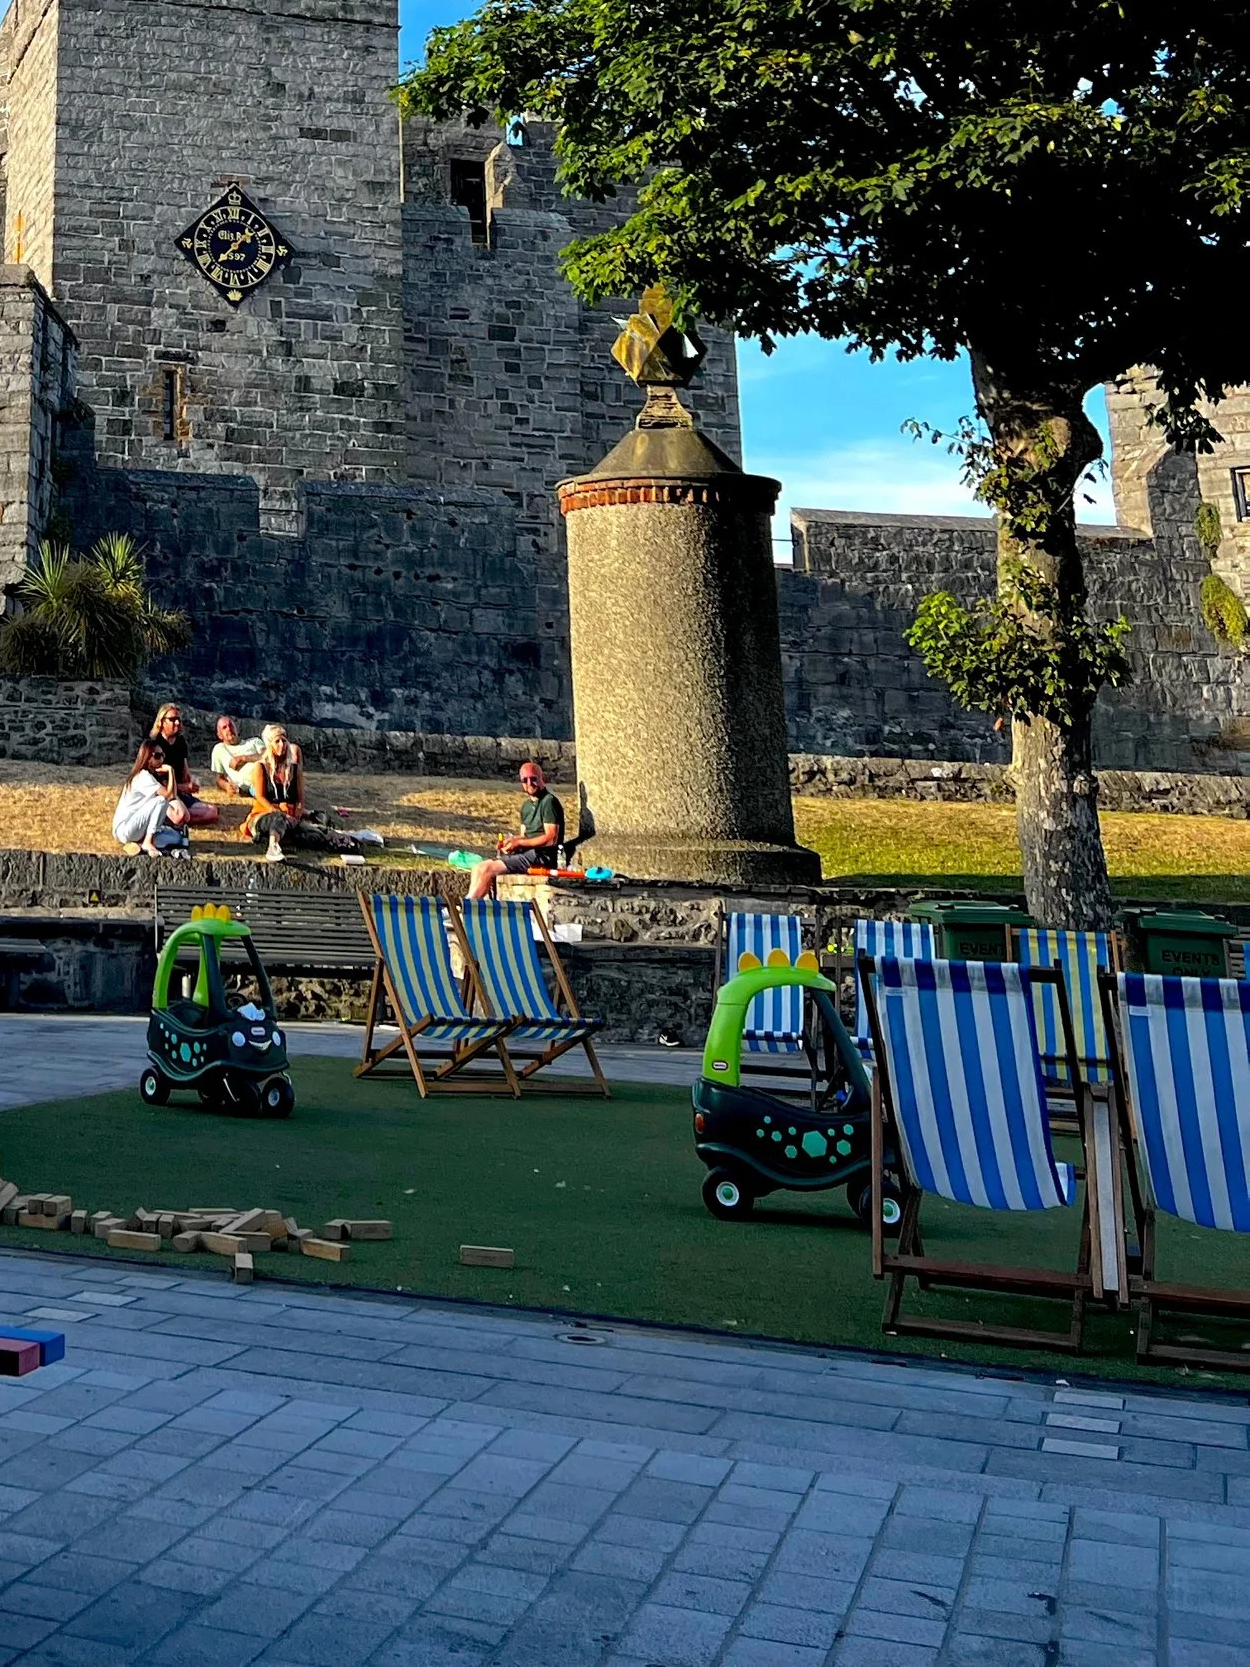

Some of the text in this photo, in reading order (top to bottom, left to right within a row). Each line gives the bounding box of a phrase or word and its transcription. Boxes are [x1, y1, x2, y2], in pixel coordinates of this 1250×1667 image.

[227, 207, 240, 219] XII
[199, 222, 212, 233] X
[257, 226, 270, 237] II
[195, 238, 207, 249] IX
[228, 252, 246, 262] 597
[230, 272, 241, 286] VI
[247, 270, 258, 284] V
[1161, 949, 1220, 966] EVENTS
